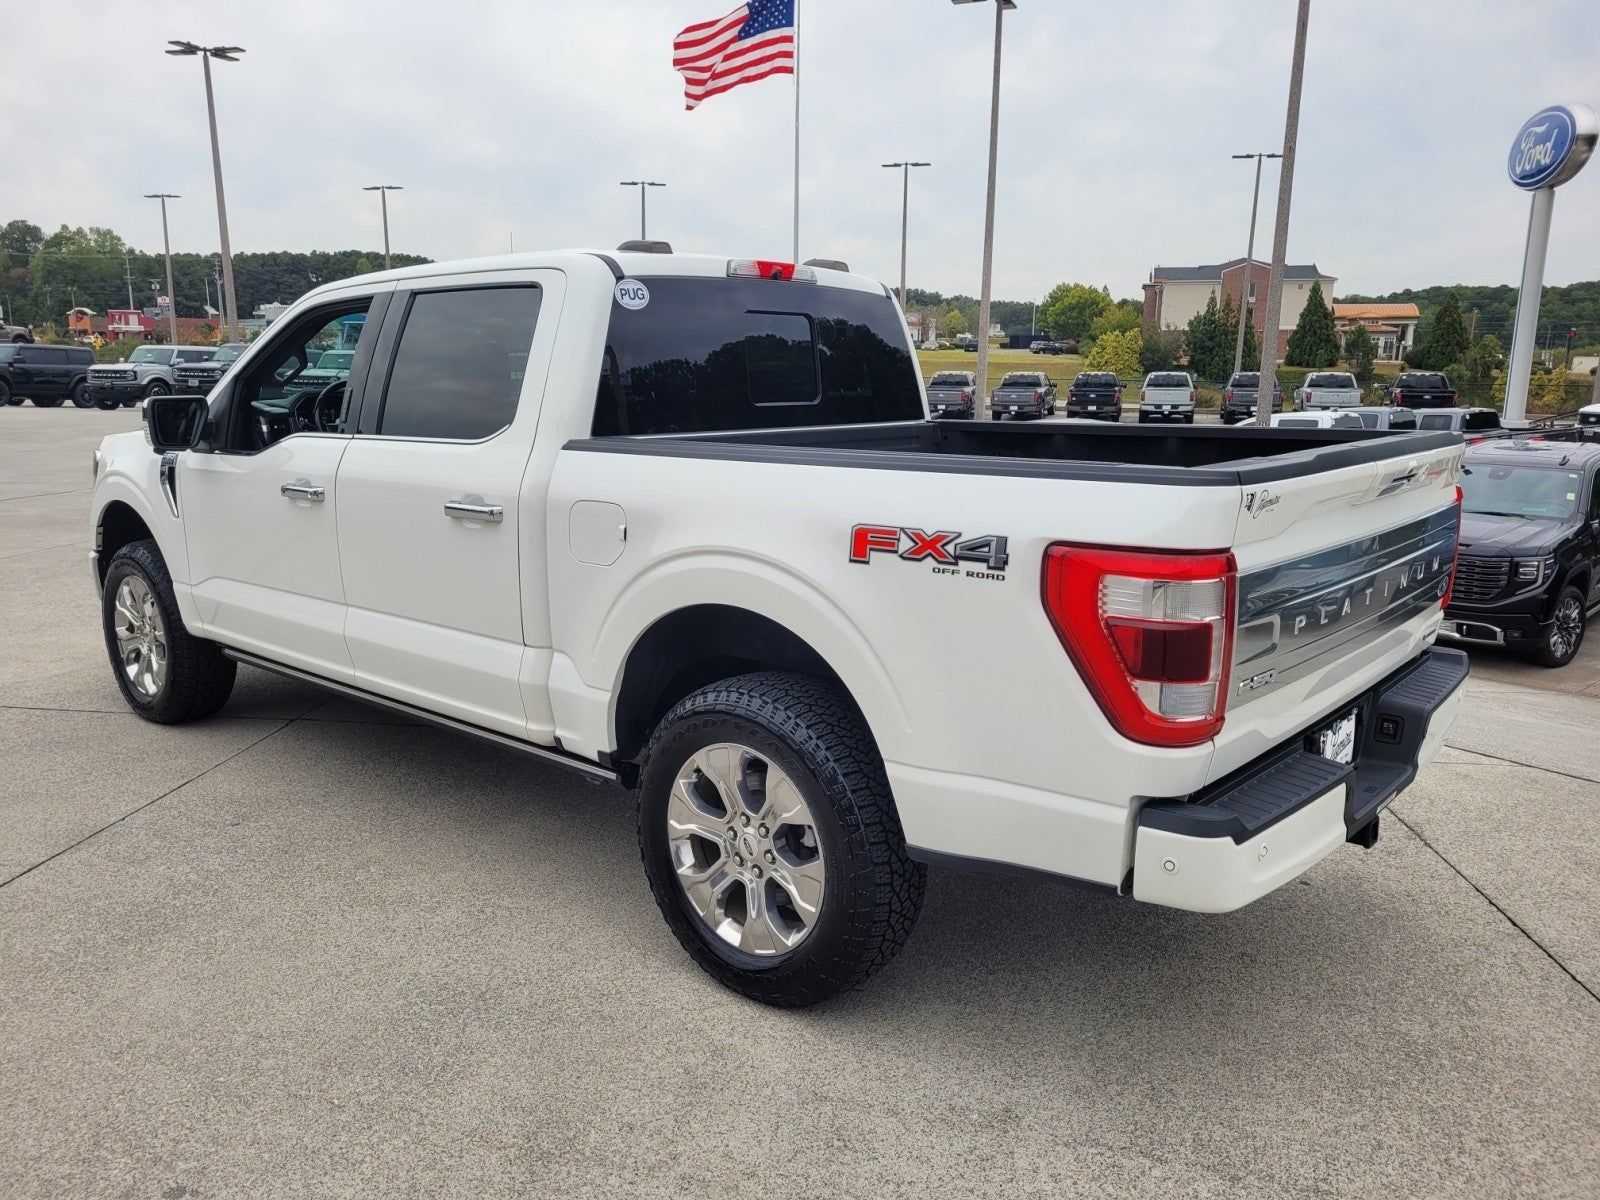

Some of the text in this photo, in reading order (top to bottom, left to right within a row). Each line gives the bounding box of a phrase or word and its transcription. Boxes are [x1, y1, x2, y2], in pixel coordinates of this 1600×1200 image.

[1515, 122, 1559, 175] Ford
[619, 287, 646, 301] PUG
[848, 523, 1009, 571] FX4
[932, 566, 1006, 582] OFF ROAD
[1294, 555, 1440, 635] PLATINUM
